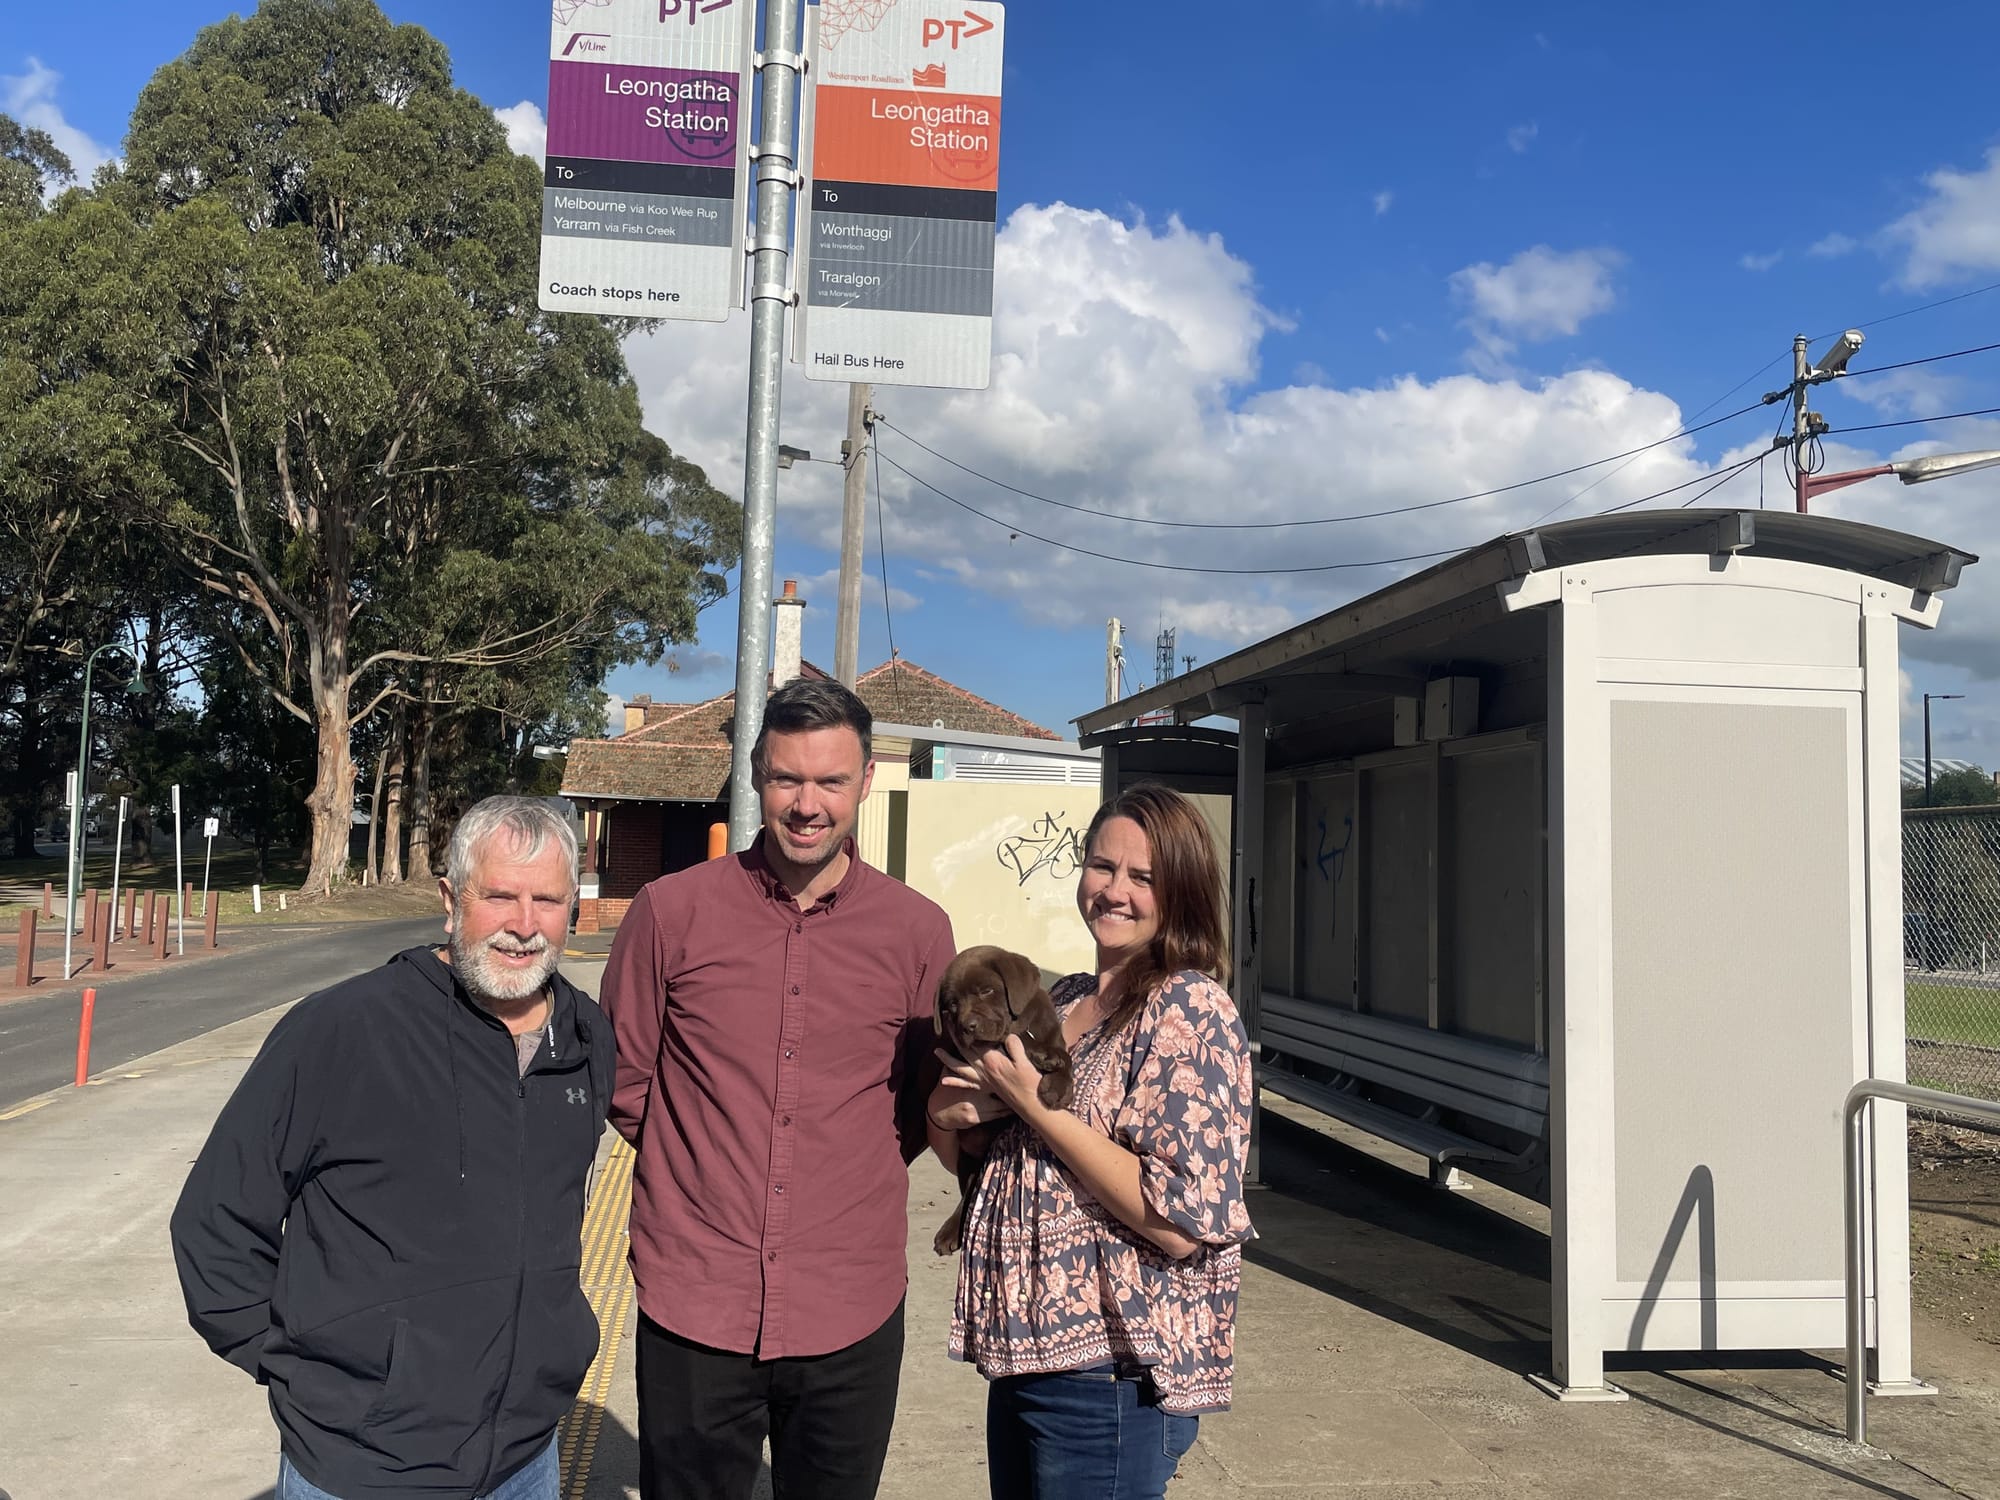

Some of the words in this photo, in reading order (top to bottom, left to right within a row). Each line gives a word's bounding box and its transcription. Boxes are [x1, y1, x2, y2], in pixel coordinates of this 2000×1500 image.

[604, 72, 731, 103] Leongatha
[645, 106, 729, 132] Station
[871, 98, 990, 127] Leongatha
[910, 127, 988, 151] Station
[555, 166, 574, 179] To
[822, 189, 839, 203] To
[554, 196, 627, 213] Melbourne
[630, 203, 645, 214] via
[647, 205, 669, 216] Koo
[671, 206, 694, 217] Wee
[696, 208, 718, 219] Rup
[553, 217, 601, 232] Yarram
[604, 223, 619, 233] via
[622, 224, 643, 235] Fish
[646, 226, 676, 237] Creek
[820, 222, 892, 242] Wonthaggi
[819, 270, 881, 288] Traralgon
[549, 282, 597, 297] Coach
[602, 286, 642, 301] stops
[648, 288, 680, 302] here
[814, 352, 839, 366] Hail
[843, 354, 869, 368] Bus
[873, 356, 904, 370] Here
